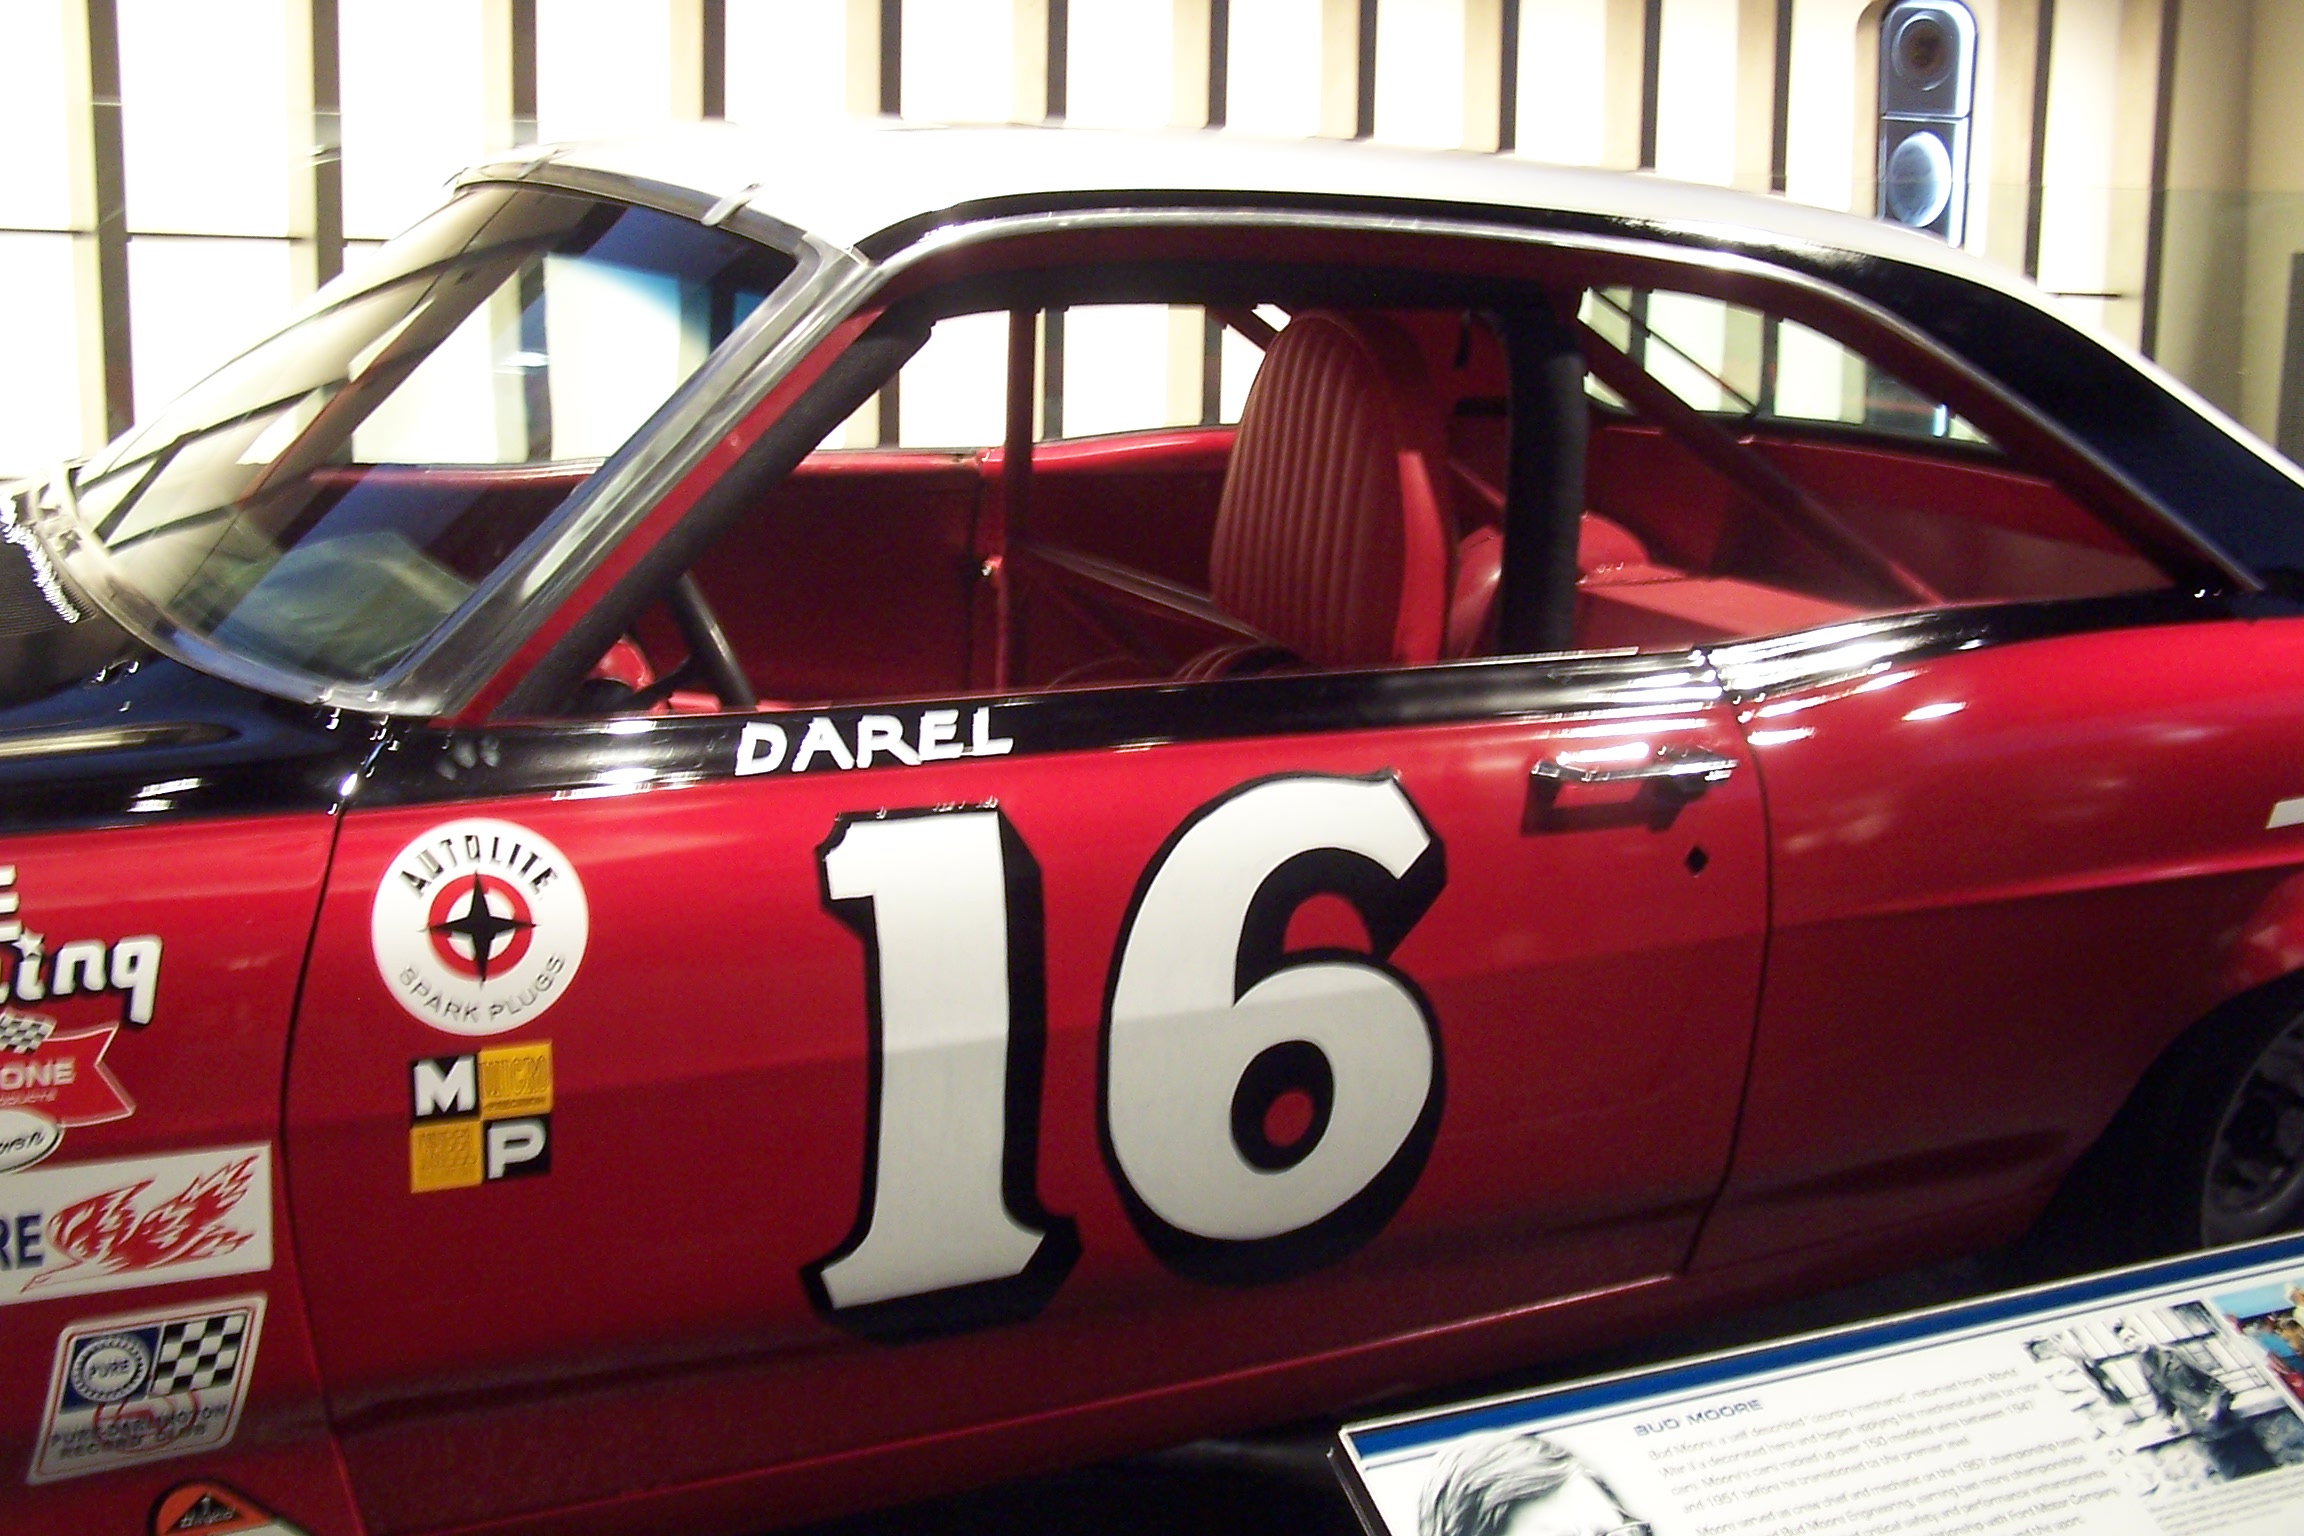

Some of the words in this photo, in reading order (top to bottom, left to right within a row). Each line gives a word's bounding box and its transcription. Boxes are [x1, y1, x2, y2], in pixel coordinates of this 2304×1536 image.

[735, 706, 1014, 777] DAREL
[400, 835, 560, 900] AUTOLITE
[399, 964, 479, 1023] SPARK
[488, 952, 566, 1022] PLUGS
[812, 770, 1440, 1322] 16
[1634, 1418, 1679, 1437] BUD
[1686, 1398, 1761, 1425] MOORE
